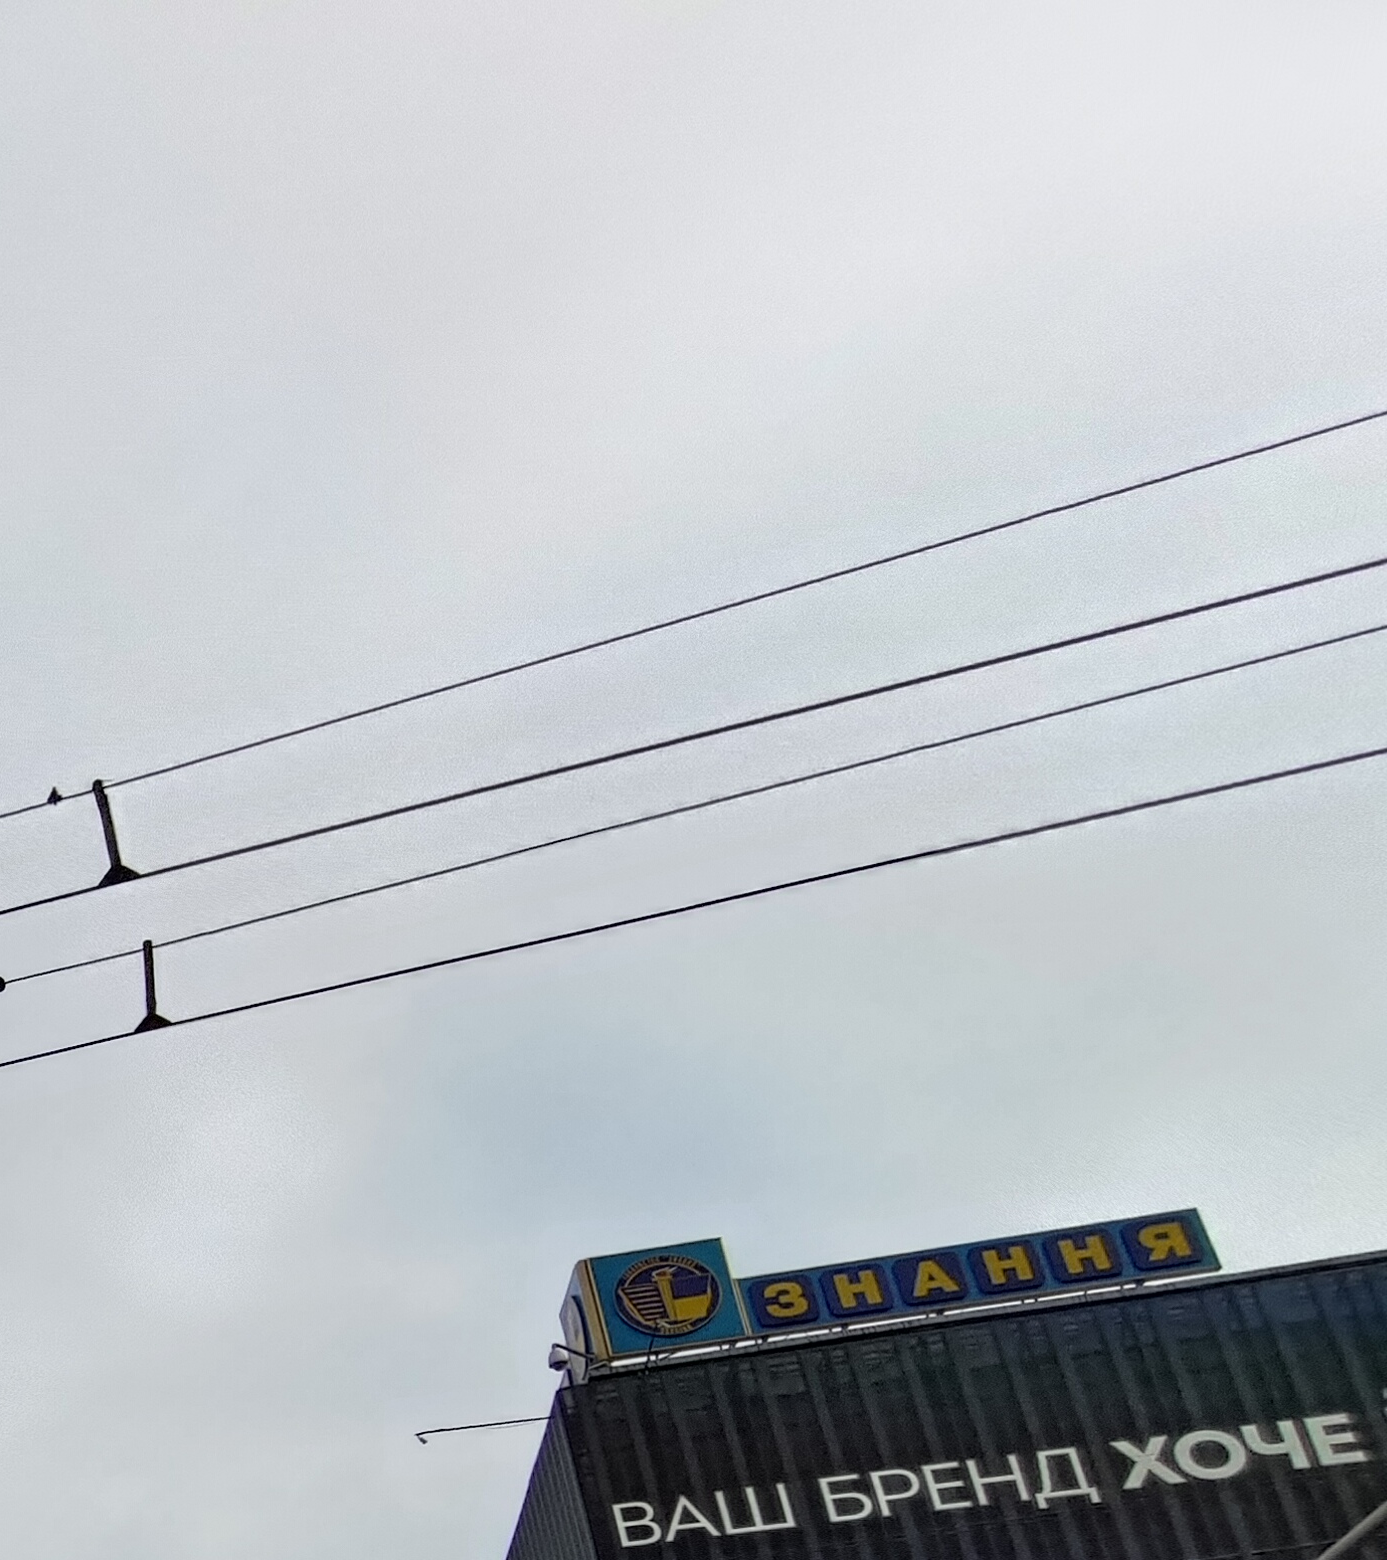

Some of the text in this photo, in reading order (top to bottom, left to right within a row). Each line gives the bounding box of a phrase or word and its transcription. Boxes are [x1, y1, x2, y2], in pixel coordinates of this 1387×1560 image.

[764, 1220, 1198, 1320] ЗНАННЯ
[611, 1412, 1370, 1548] ВАШ БРЕНД ХОЧЕ
